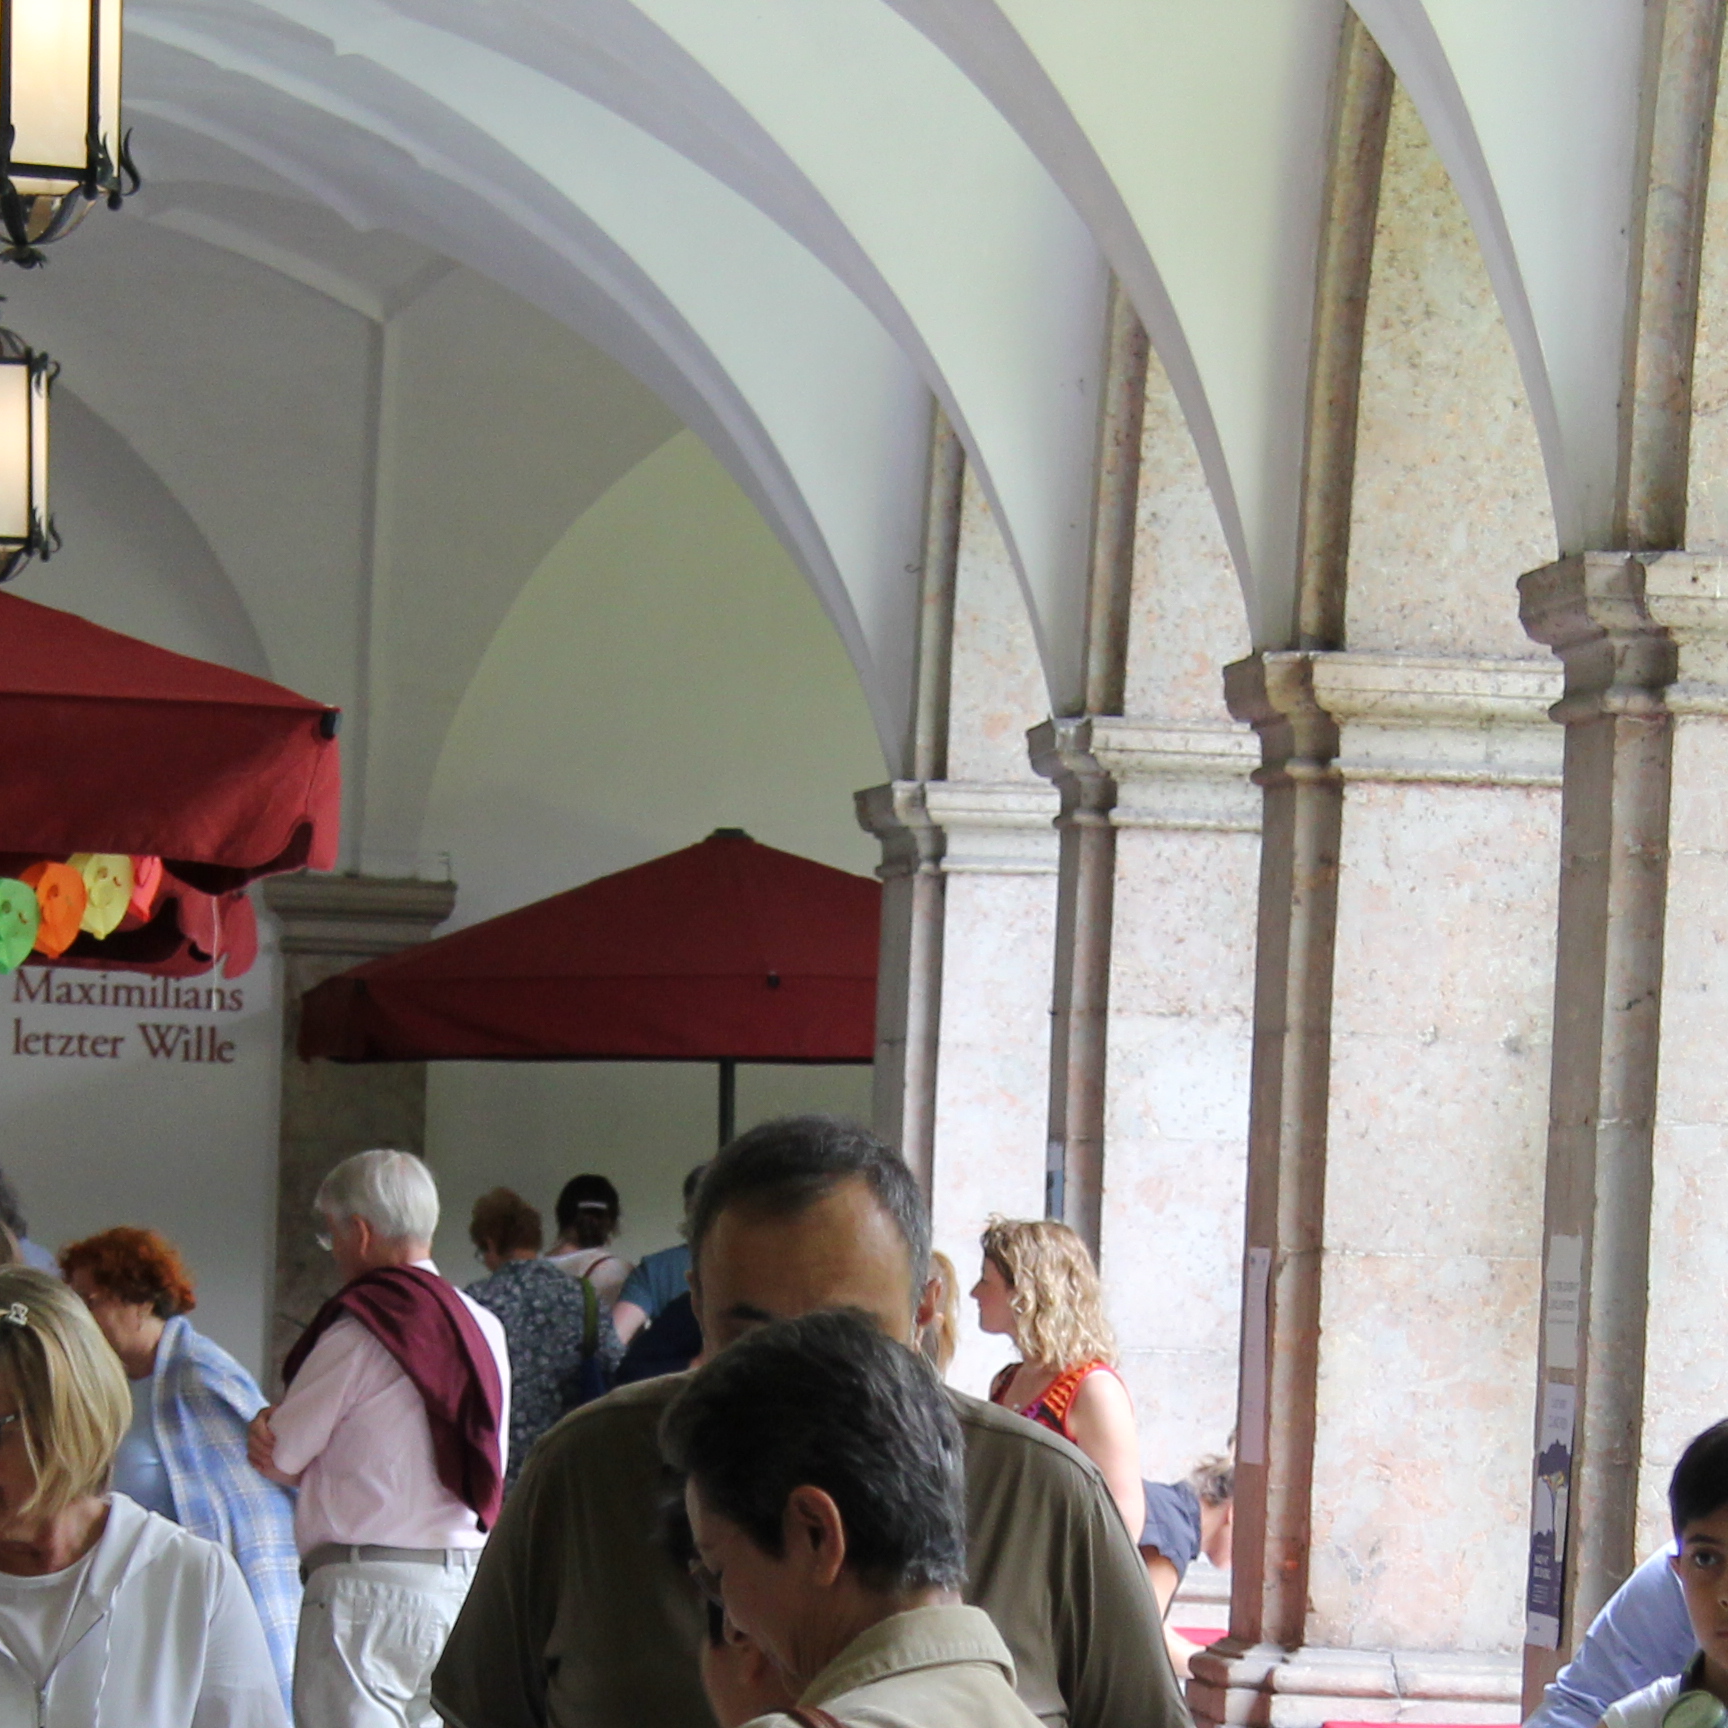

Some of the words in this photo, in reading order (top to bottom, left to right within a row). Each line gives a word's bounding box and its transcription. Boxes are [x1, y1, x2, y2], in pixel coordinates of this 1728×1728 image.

[13, 967, 245, 1012] Maximilians
[13, 1017, 125, 1058] letzter
[138, 1022, 236, 1063] Wille
